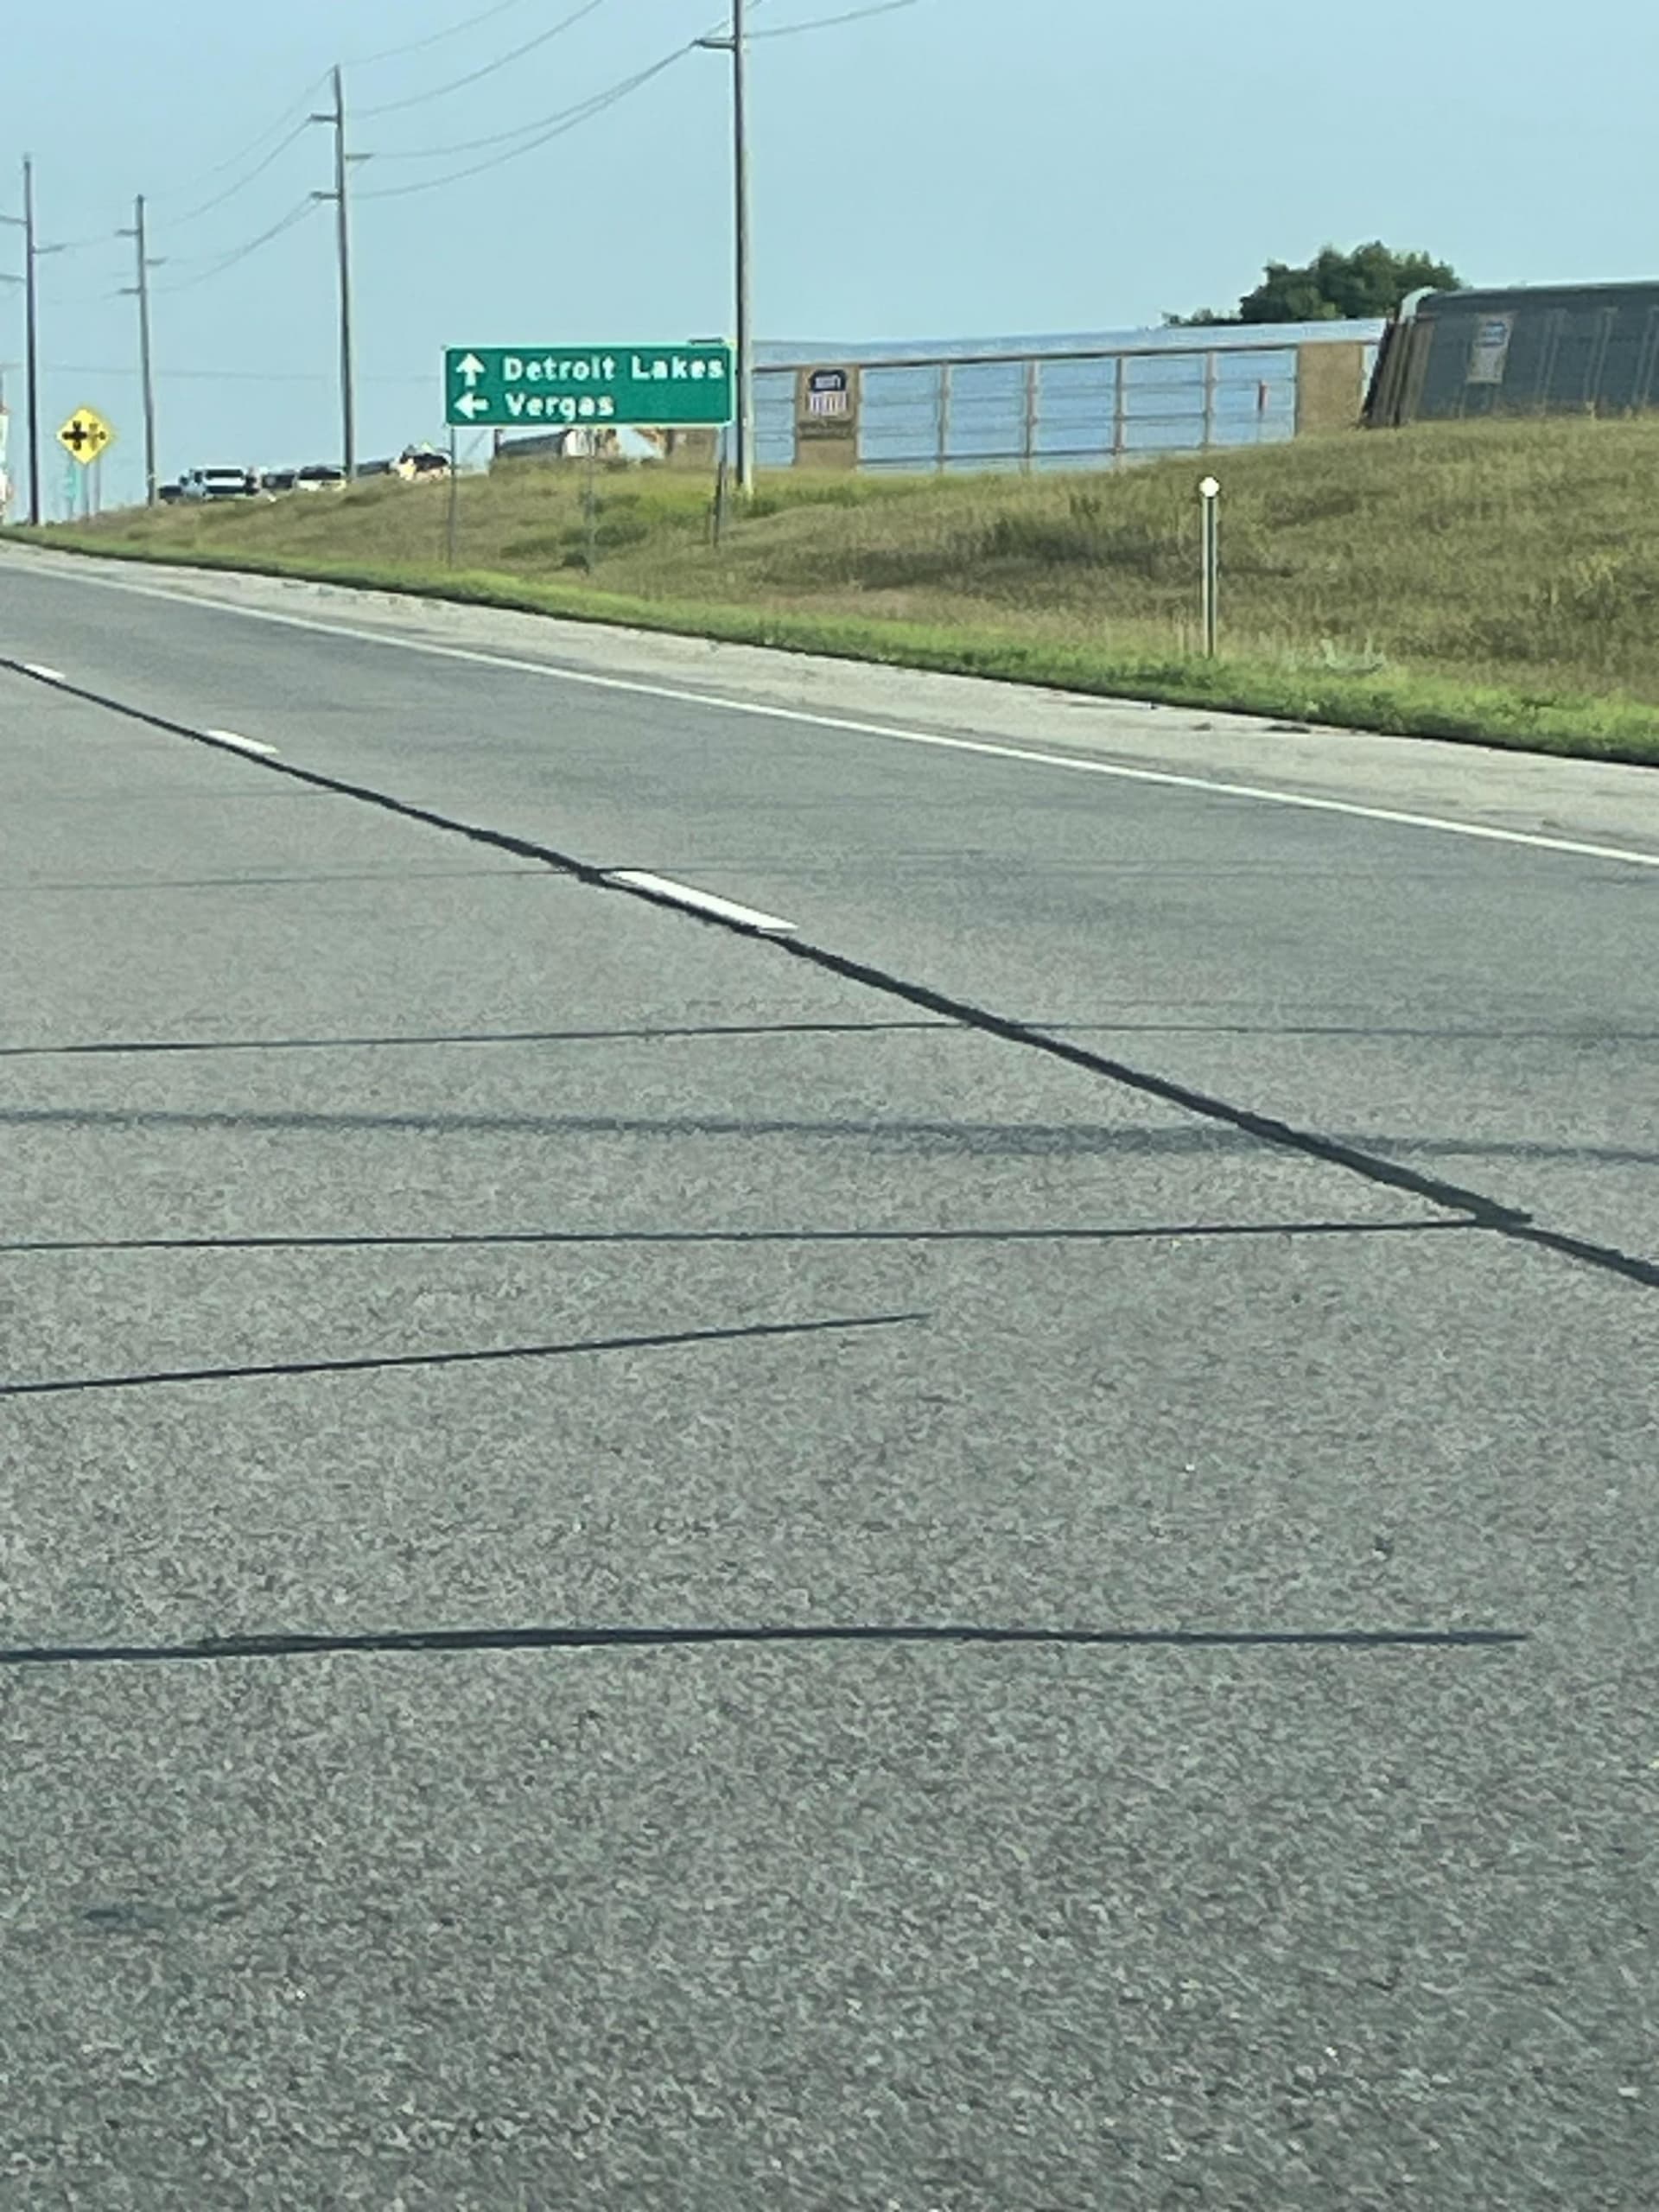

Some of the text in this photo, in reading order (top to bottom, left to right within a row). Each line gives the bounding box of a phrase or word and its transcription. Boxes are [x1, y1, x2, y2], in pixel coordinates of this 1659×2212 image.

[503, 354, 726, 382] Detroit Lakes
[505, 391, 615, 422] Vergas
